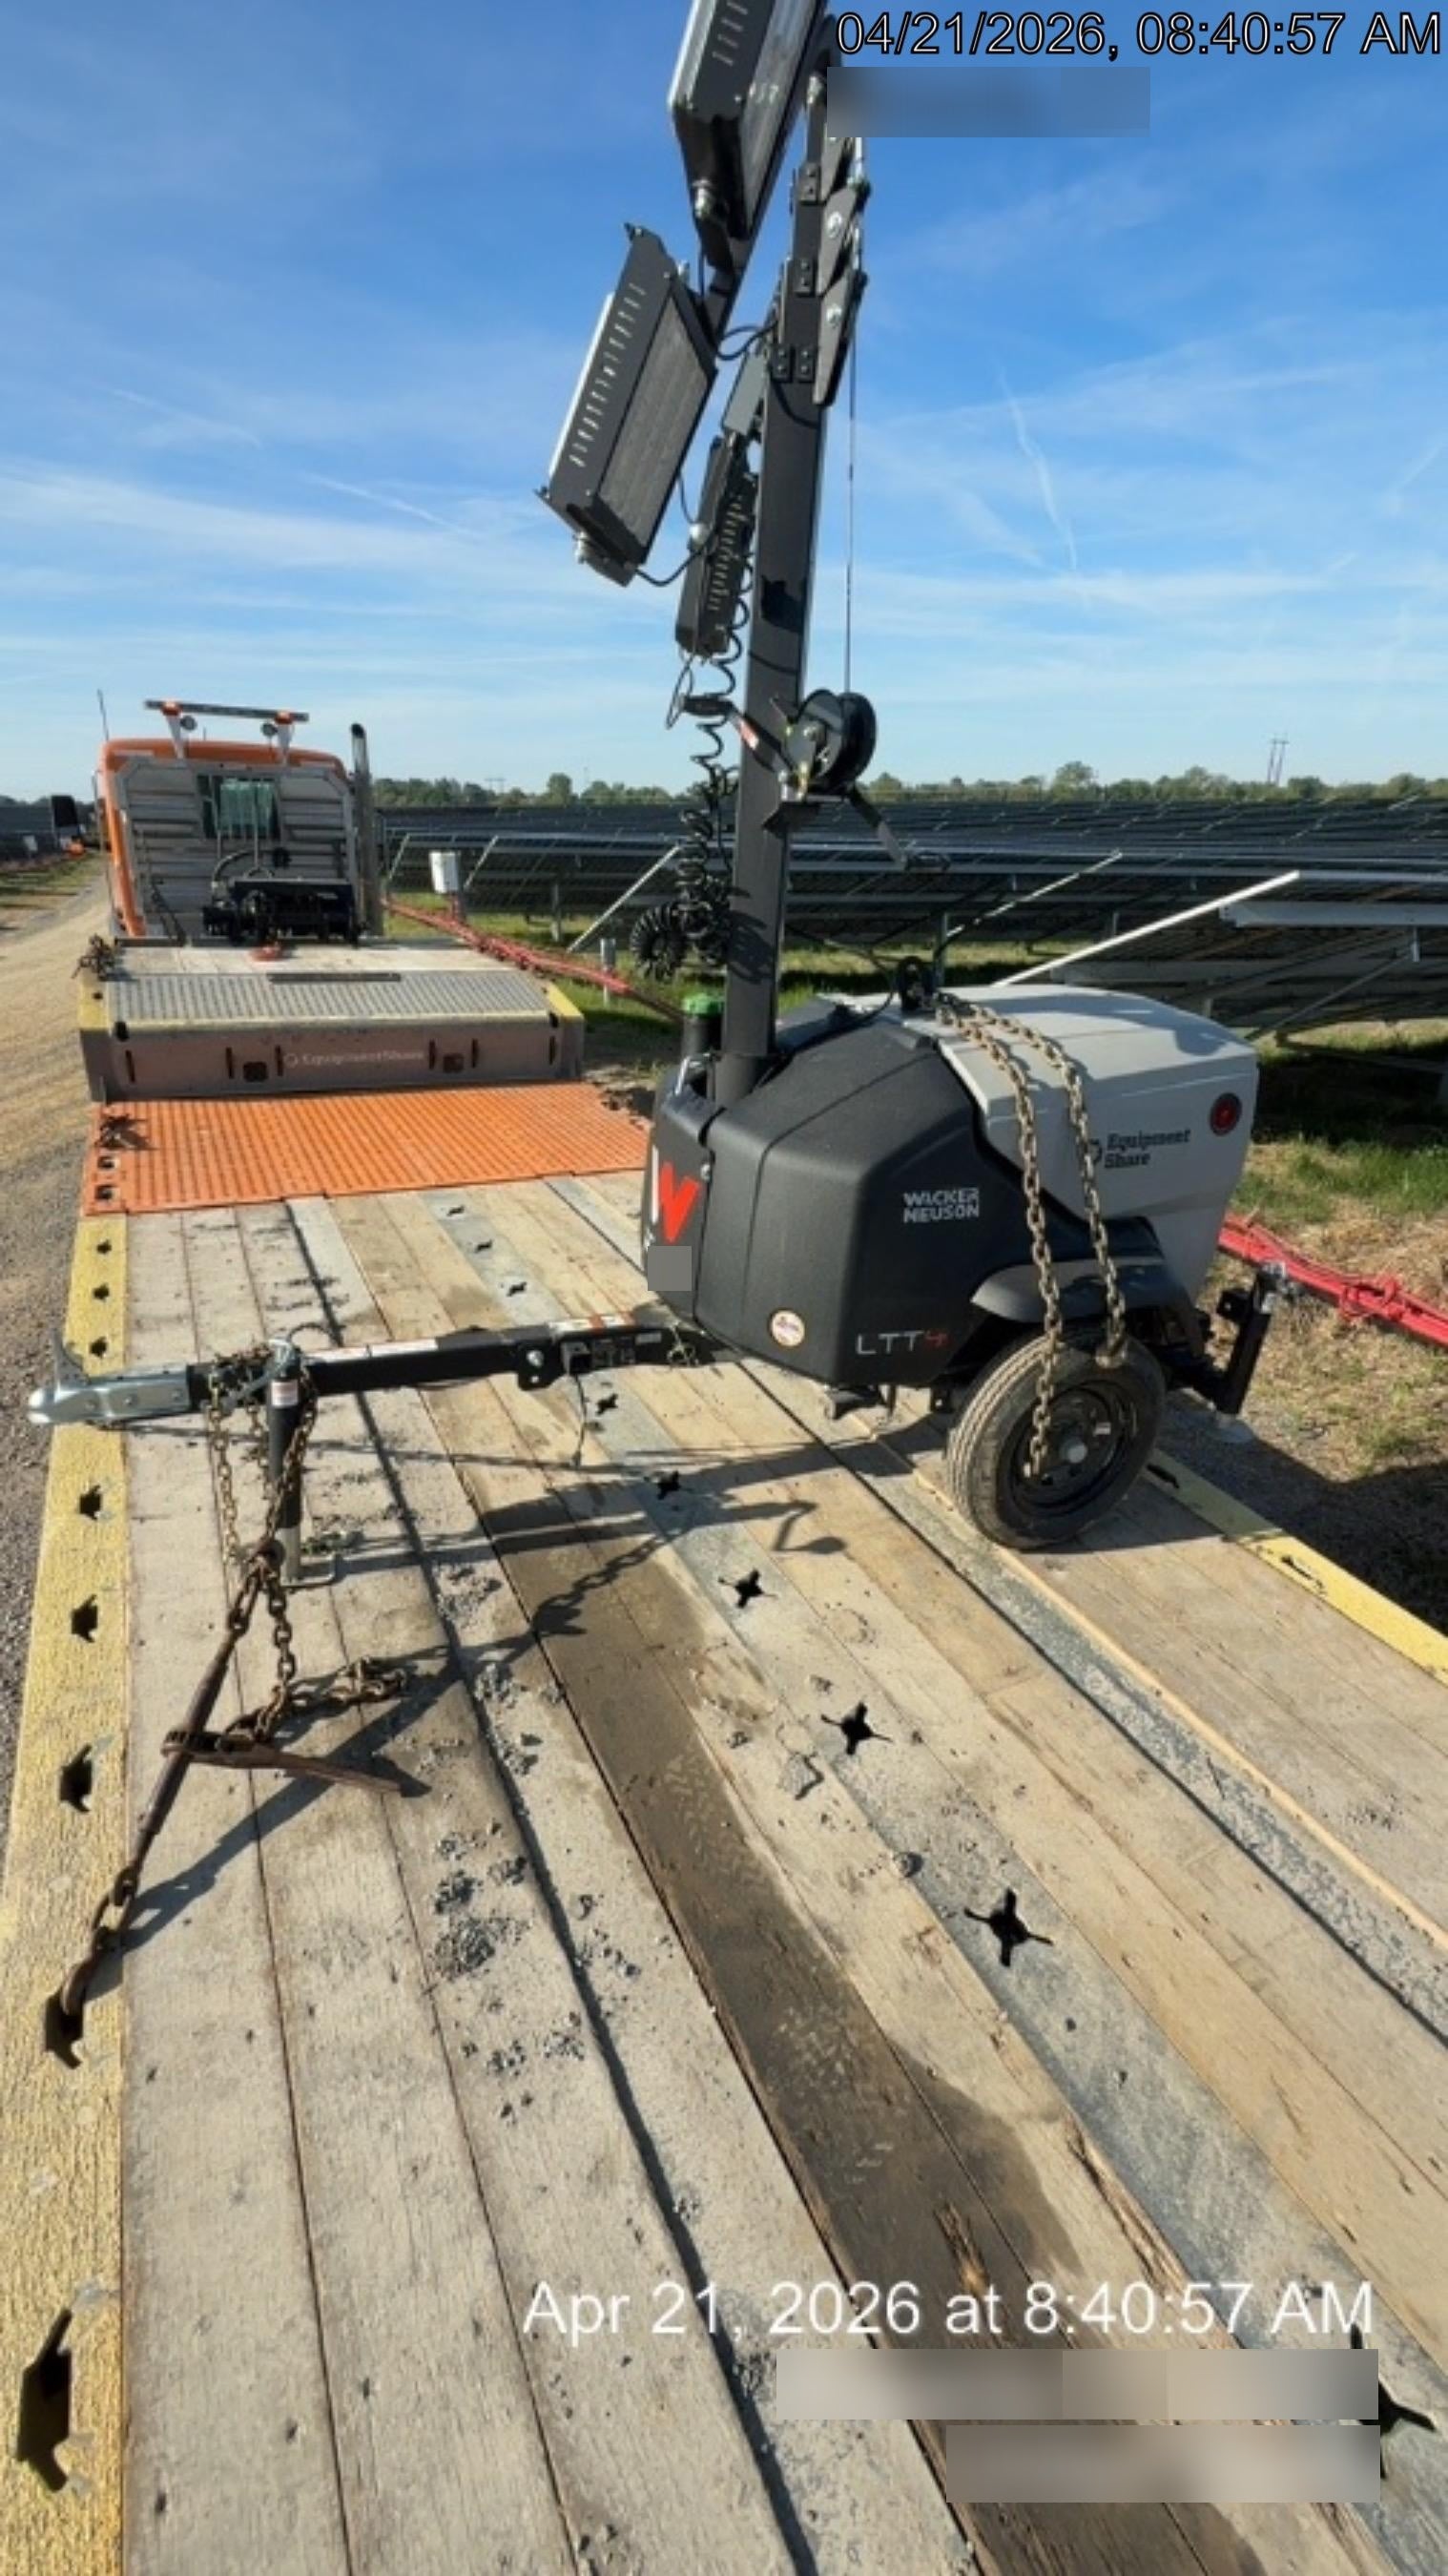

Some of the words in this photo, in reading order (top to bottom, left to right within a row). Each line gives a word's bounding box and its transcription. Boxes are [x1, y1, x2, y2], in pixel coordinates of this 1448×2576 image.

[1107, 1129, 1191, 1151] Equipment
[1104, 1152, 1151, 1169] Share
[902, 1187, 980, 1207] WACKER
[902, 1203, 980, 1223] NEUSON
[855, 1329, 948, 1355] LTT4
